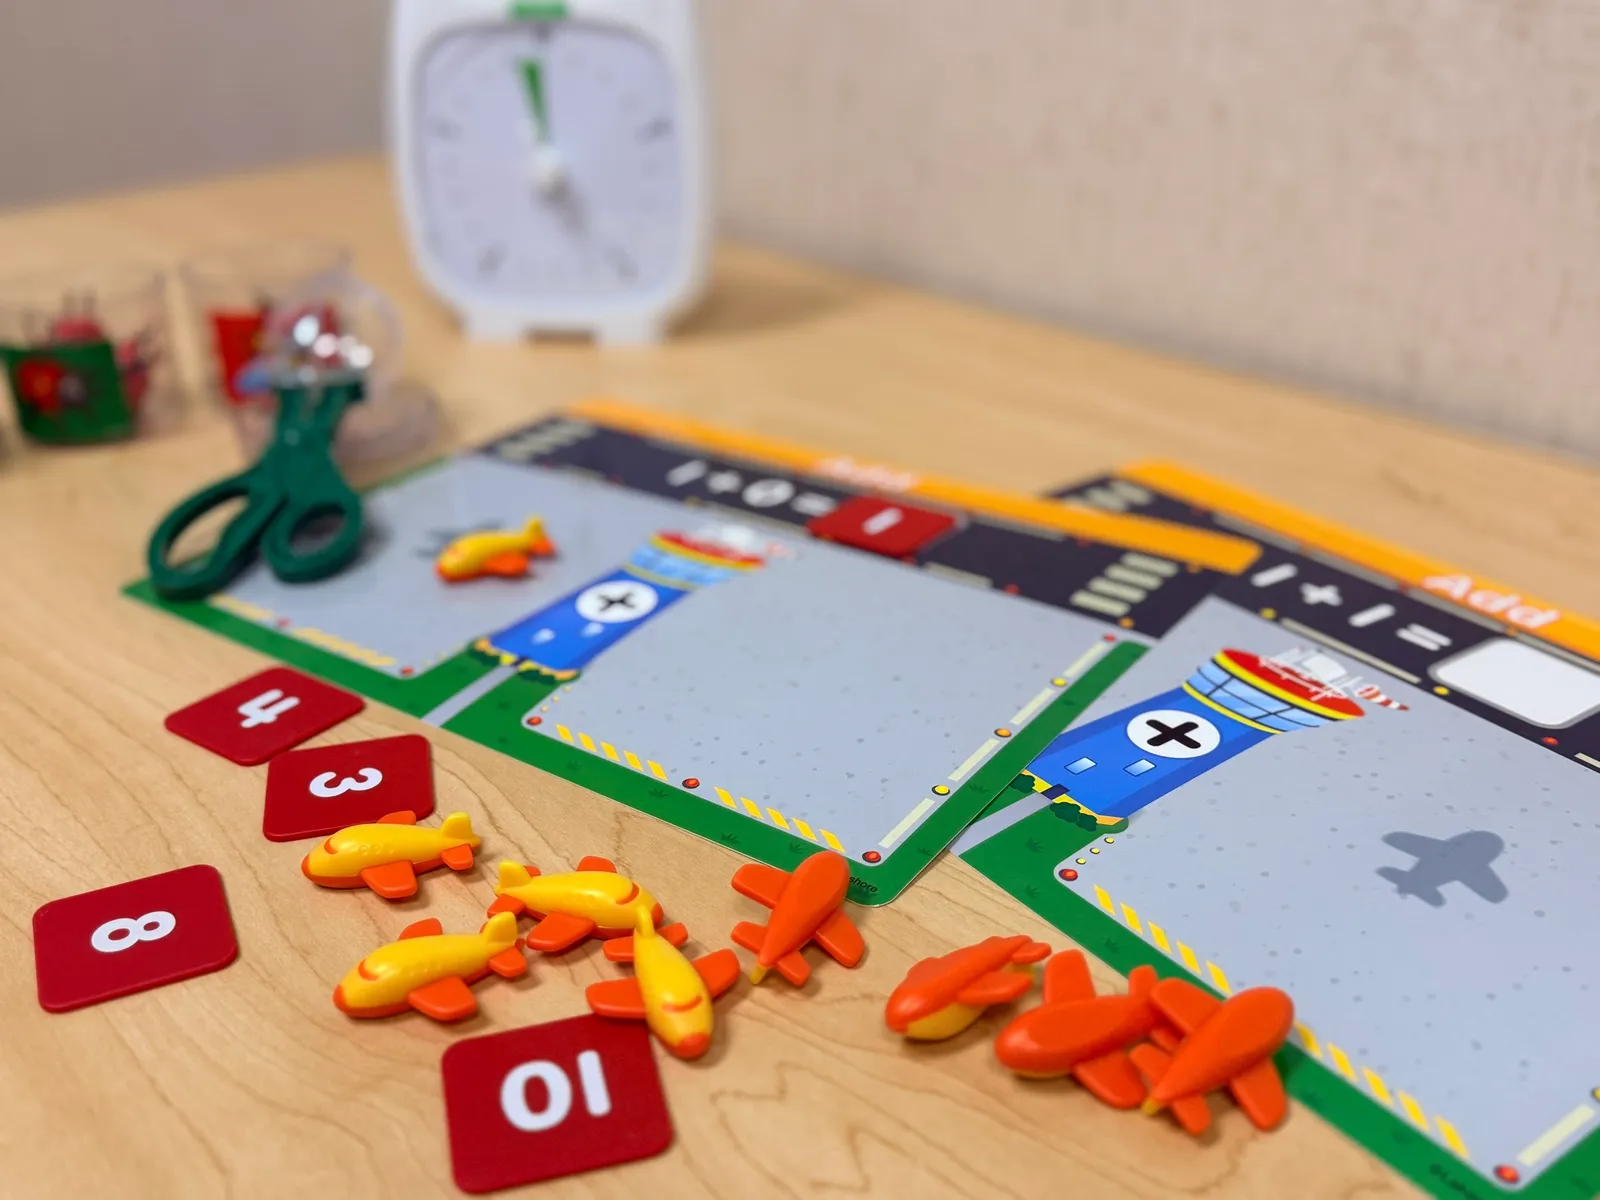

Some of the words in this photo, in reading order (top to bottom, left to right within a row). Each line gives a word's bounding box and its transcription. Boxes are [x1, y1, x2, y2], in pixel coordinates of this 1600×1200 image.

[1421, 574, 1561, 629] Add
[237, 689, 300, 728] 4
[309, 767, 383, 797] 3
[849, 876, 878, 893] shore
[91, 910, 176, 952] 8
[501, 1049, 611, 1132] 10
